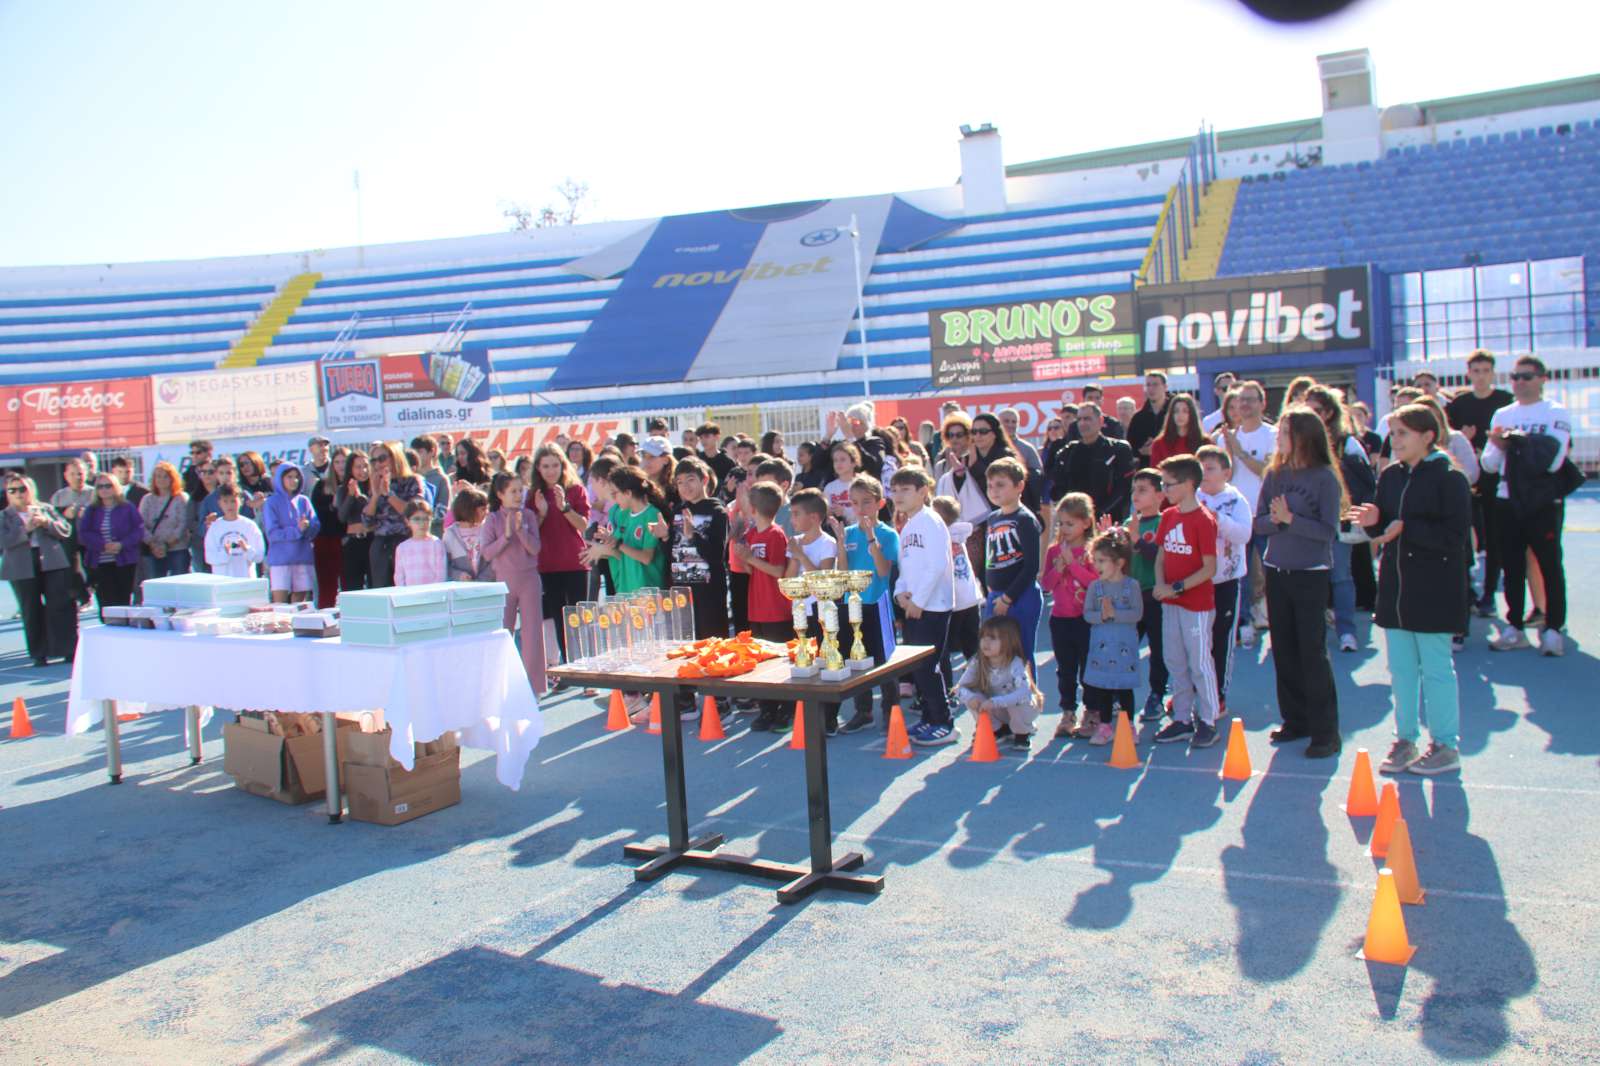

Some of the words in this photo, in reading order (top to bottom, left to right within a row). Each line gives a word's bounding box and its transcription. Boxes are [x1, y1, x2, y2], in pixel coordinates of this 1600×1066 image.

[653, 256, 834, 288] novibet
[940, 294, 1116, 346] BRUNO'S
[1144, 289, 1363, 354] novibet
[1065, 341, 1086, 353] pet
[1091, 338, 1122, 353] shop
[185, 370, 309, 393] MEGASYSTEMS
[23, 386, 125, 415] Πρόεδρος
[398, 406, 473, 422] dialinas.gr
